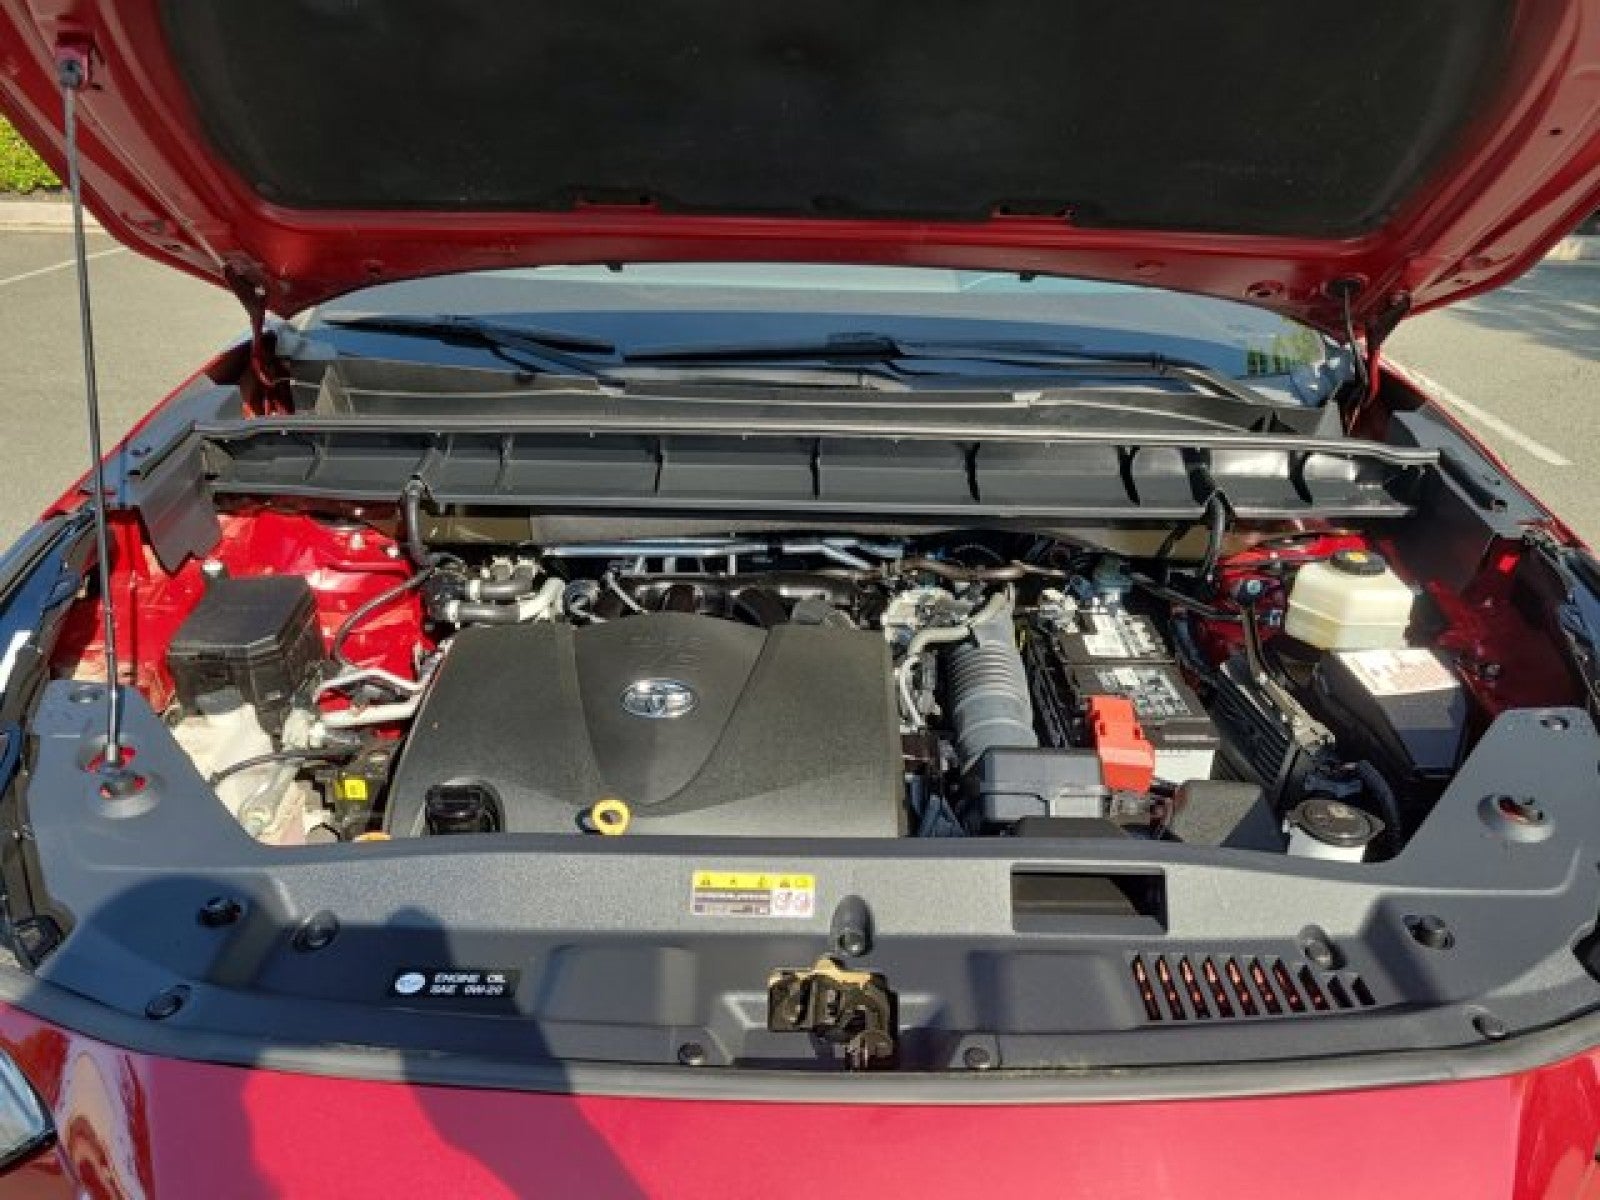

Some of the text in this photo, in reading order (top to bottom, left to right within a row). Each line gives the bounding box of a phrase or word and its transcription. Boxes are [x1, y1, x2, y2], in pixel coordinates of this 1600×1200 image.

[434, 973, 506, 983] ENGINE OIL
[430, 984, 456, 995] SAE
